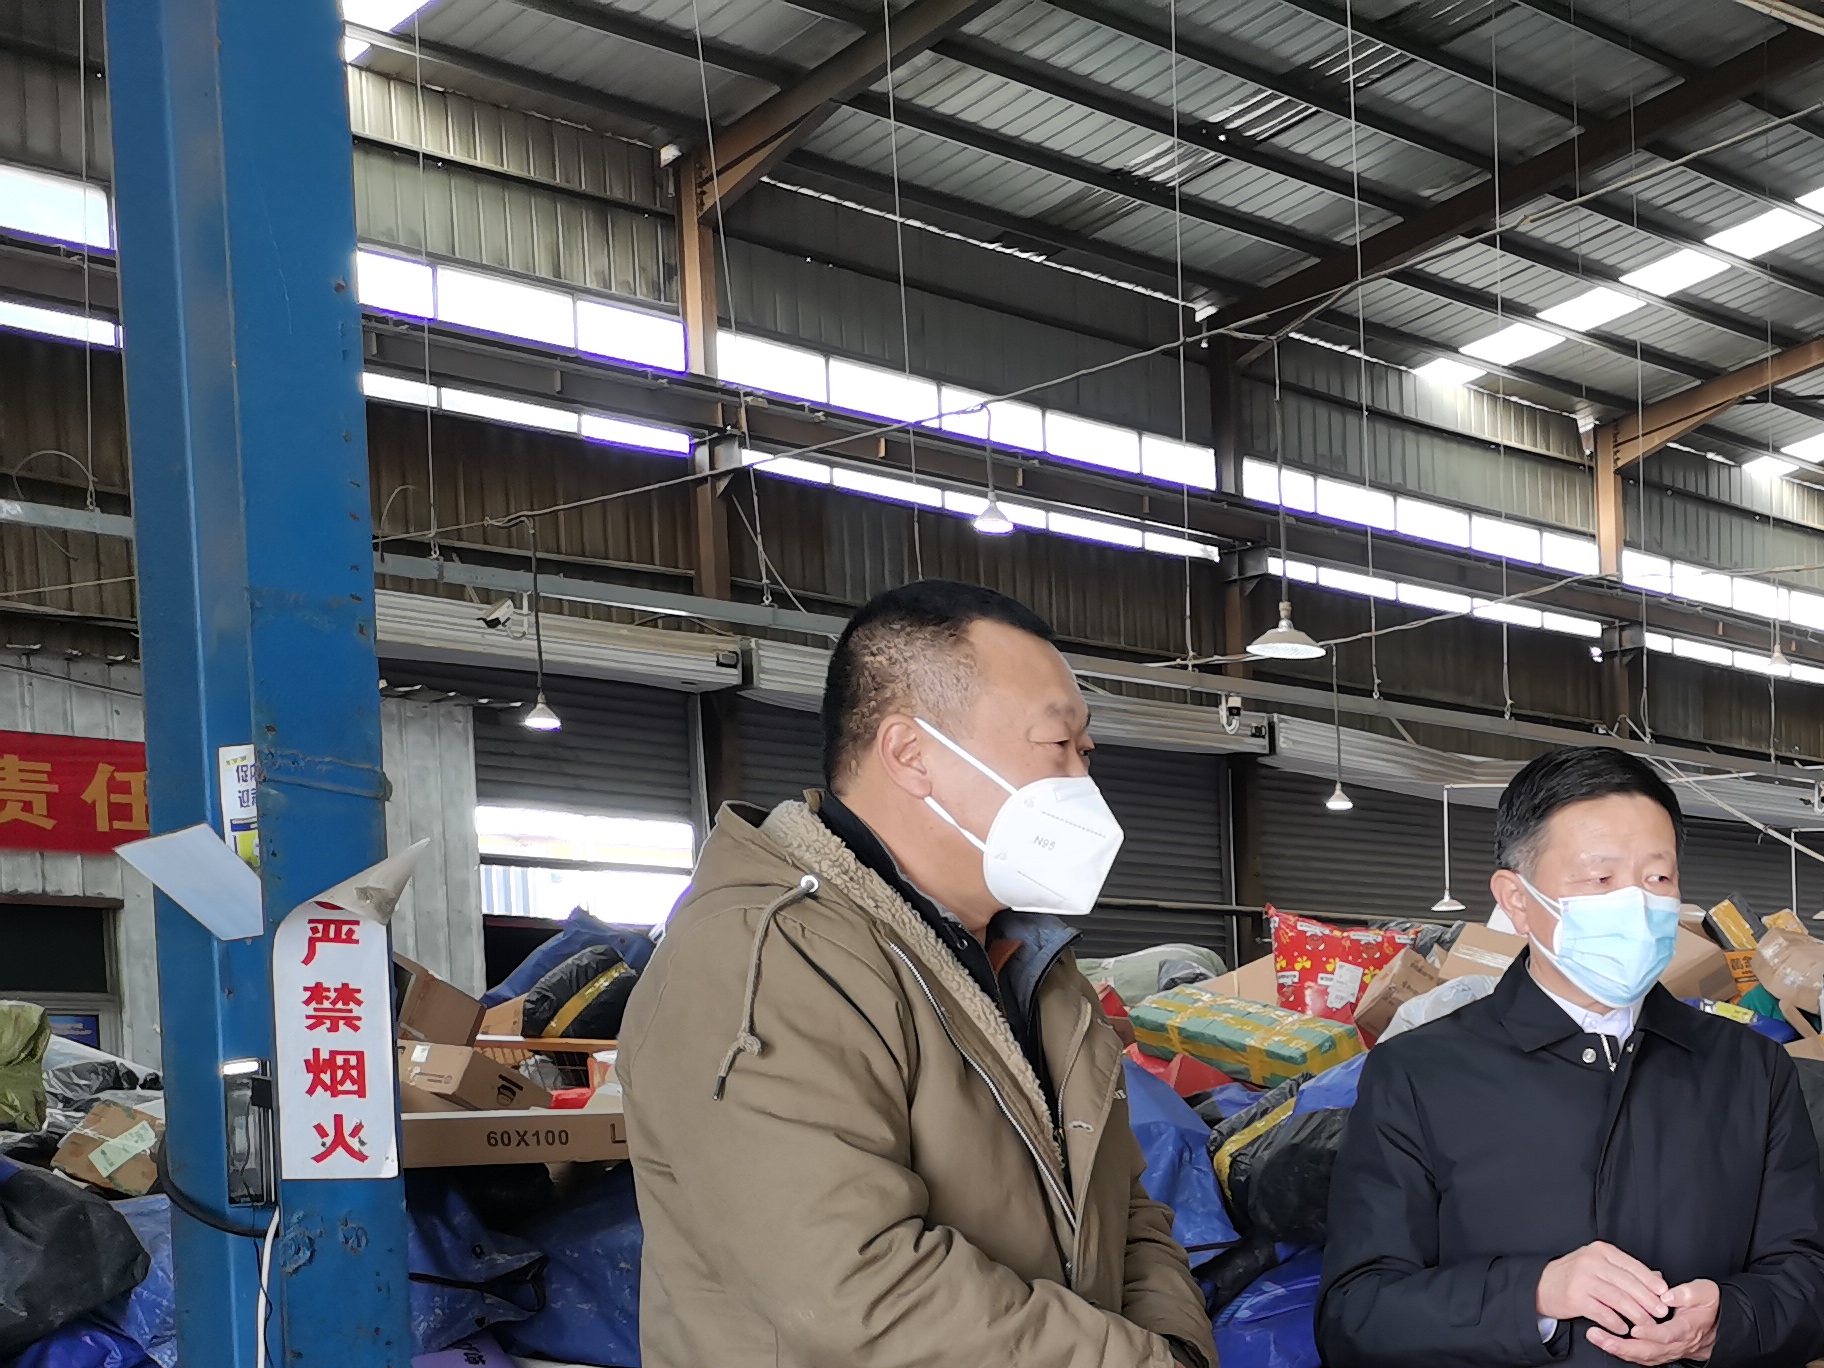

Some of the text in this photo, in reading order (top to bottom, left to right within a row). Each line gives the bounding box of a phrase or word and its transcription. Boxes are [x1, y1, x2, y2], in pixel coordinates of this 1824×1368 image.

[1033, 835, 1056, 851] N95
[301, 919, 370, 1163] 严禁烟火
[486, 1129, 569, 1148] 60X100
